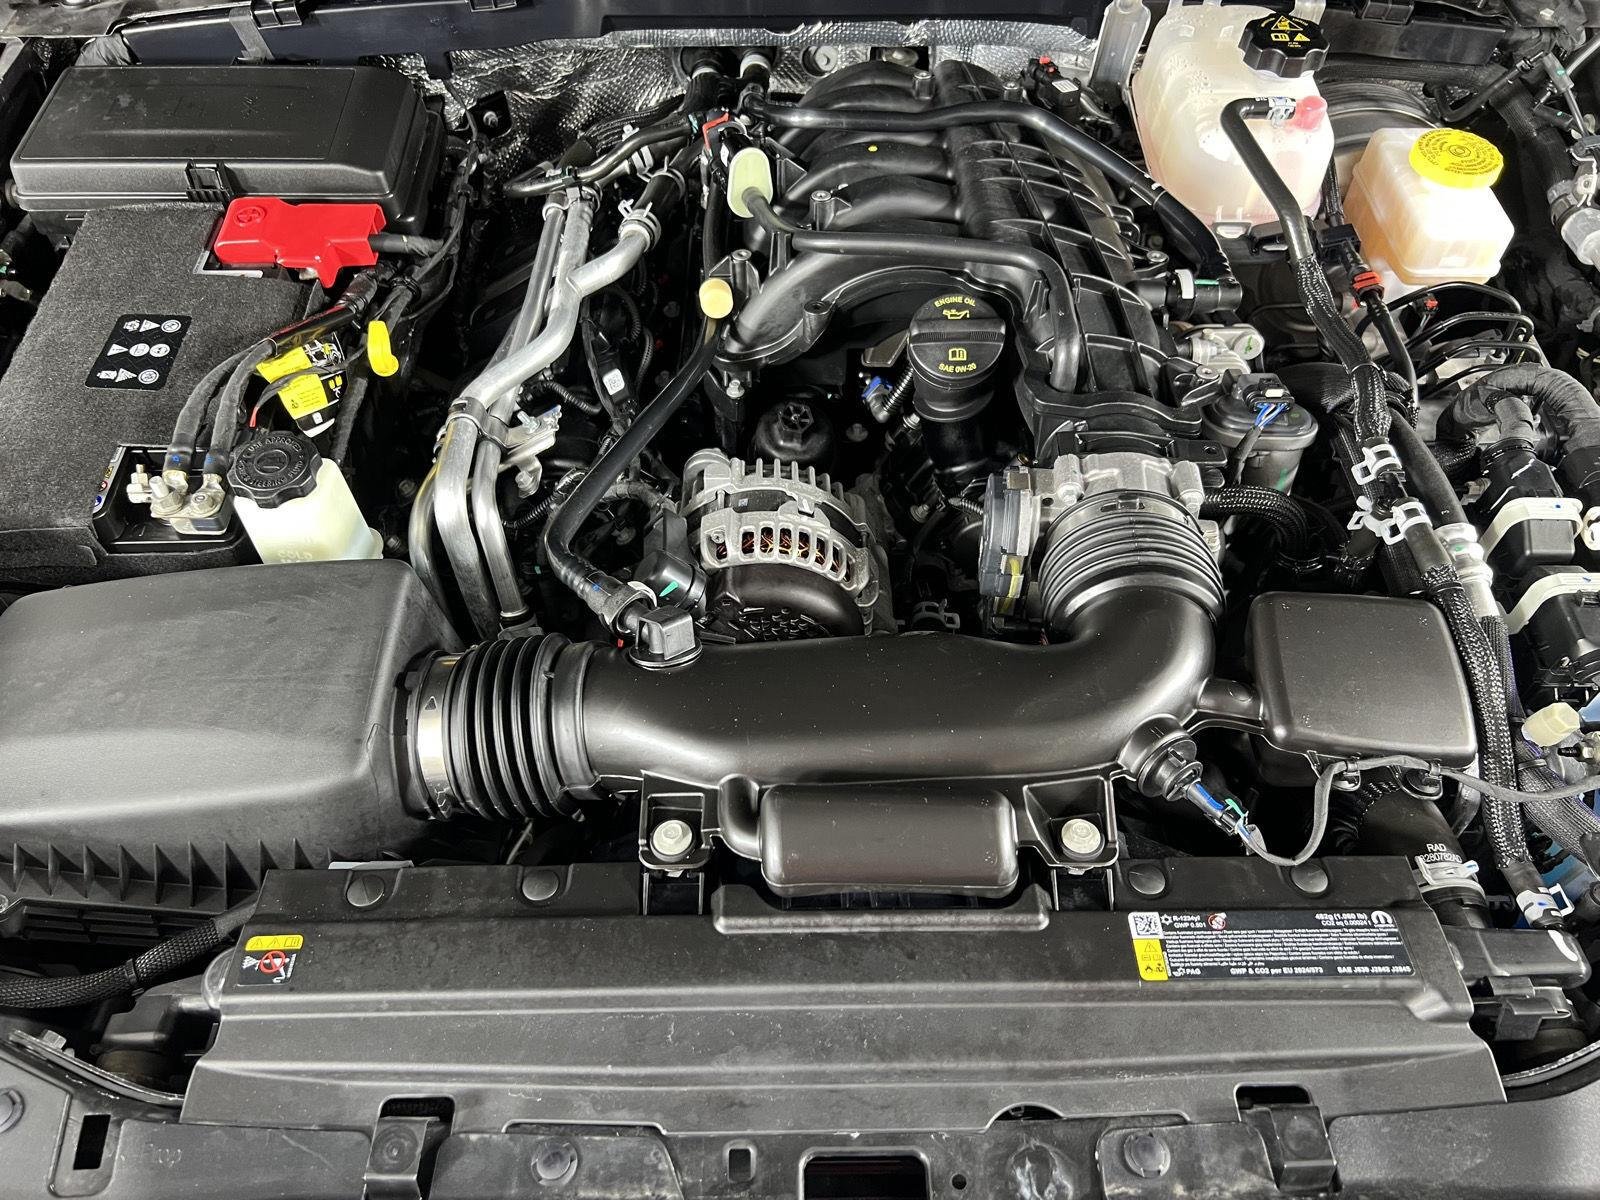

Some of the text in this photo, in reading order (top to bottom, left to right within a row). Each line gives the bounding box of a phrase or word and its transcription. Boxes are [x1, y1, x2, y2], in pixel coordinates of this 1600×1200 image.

[934, 296, 976, 308] ENGINE OIL
[938, 362, 977, 373] SAE 0W-20
[1426, 843, 1447, 852] RAD
